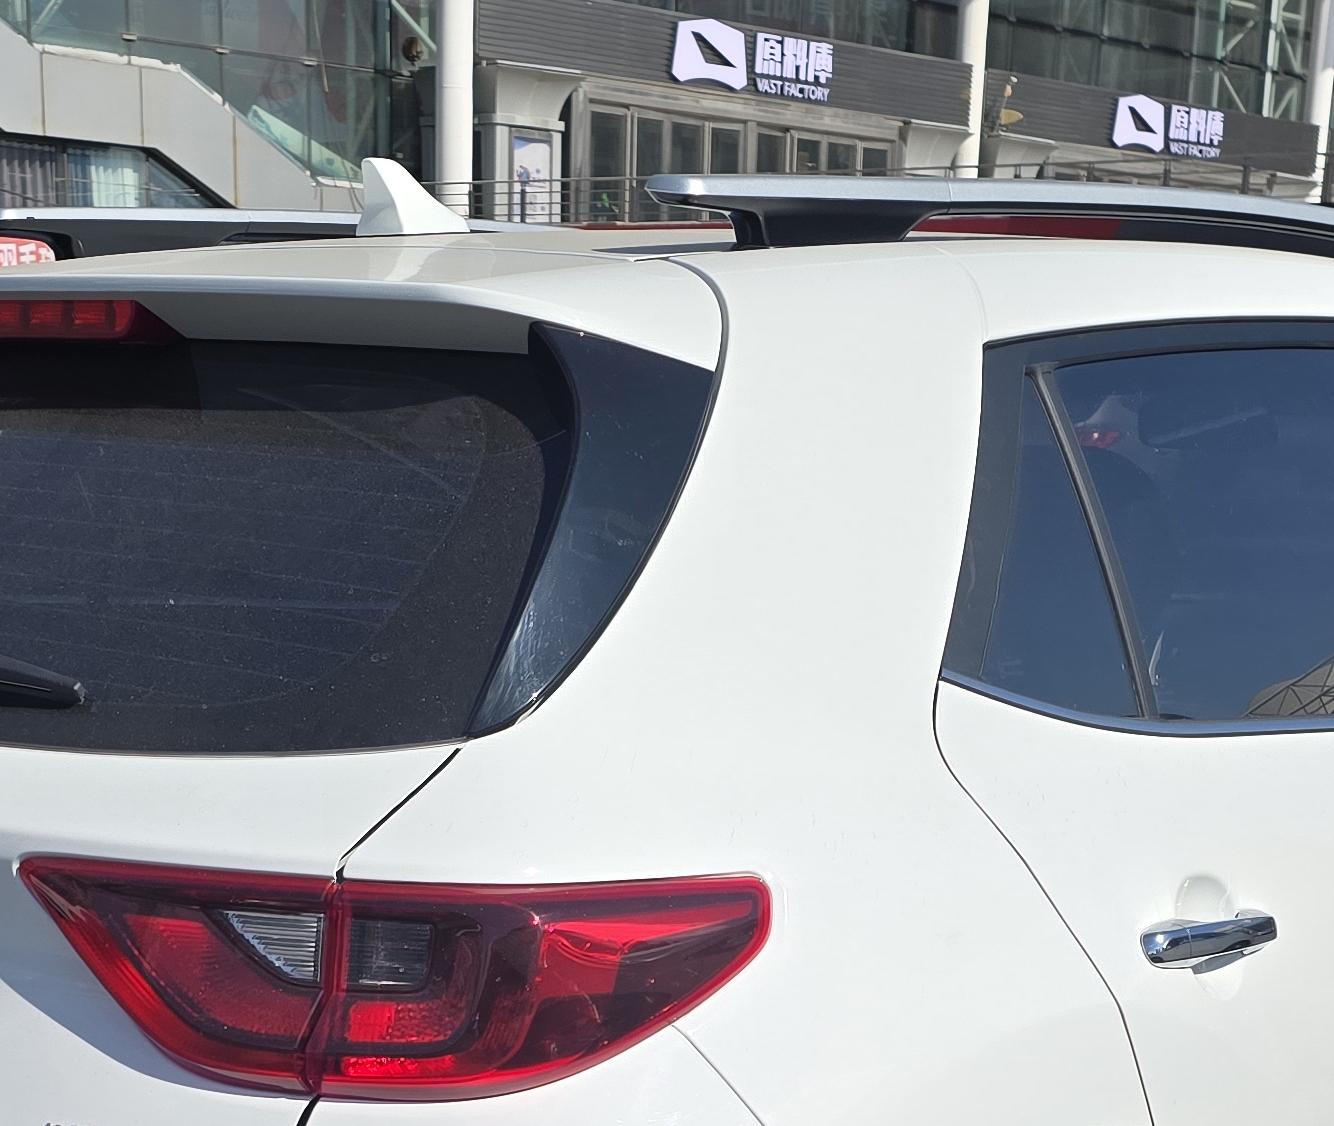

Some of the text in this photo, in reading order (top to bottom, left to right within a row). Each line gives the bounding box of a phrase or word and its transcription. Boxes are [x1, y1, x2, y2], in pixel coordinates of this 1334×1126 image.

[756, 78, 830, 101] VAST FACTORY
[1168, 140, 1221, 158] VAST FACTORY
